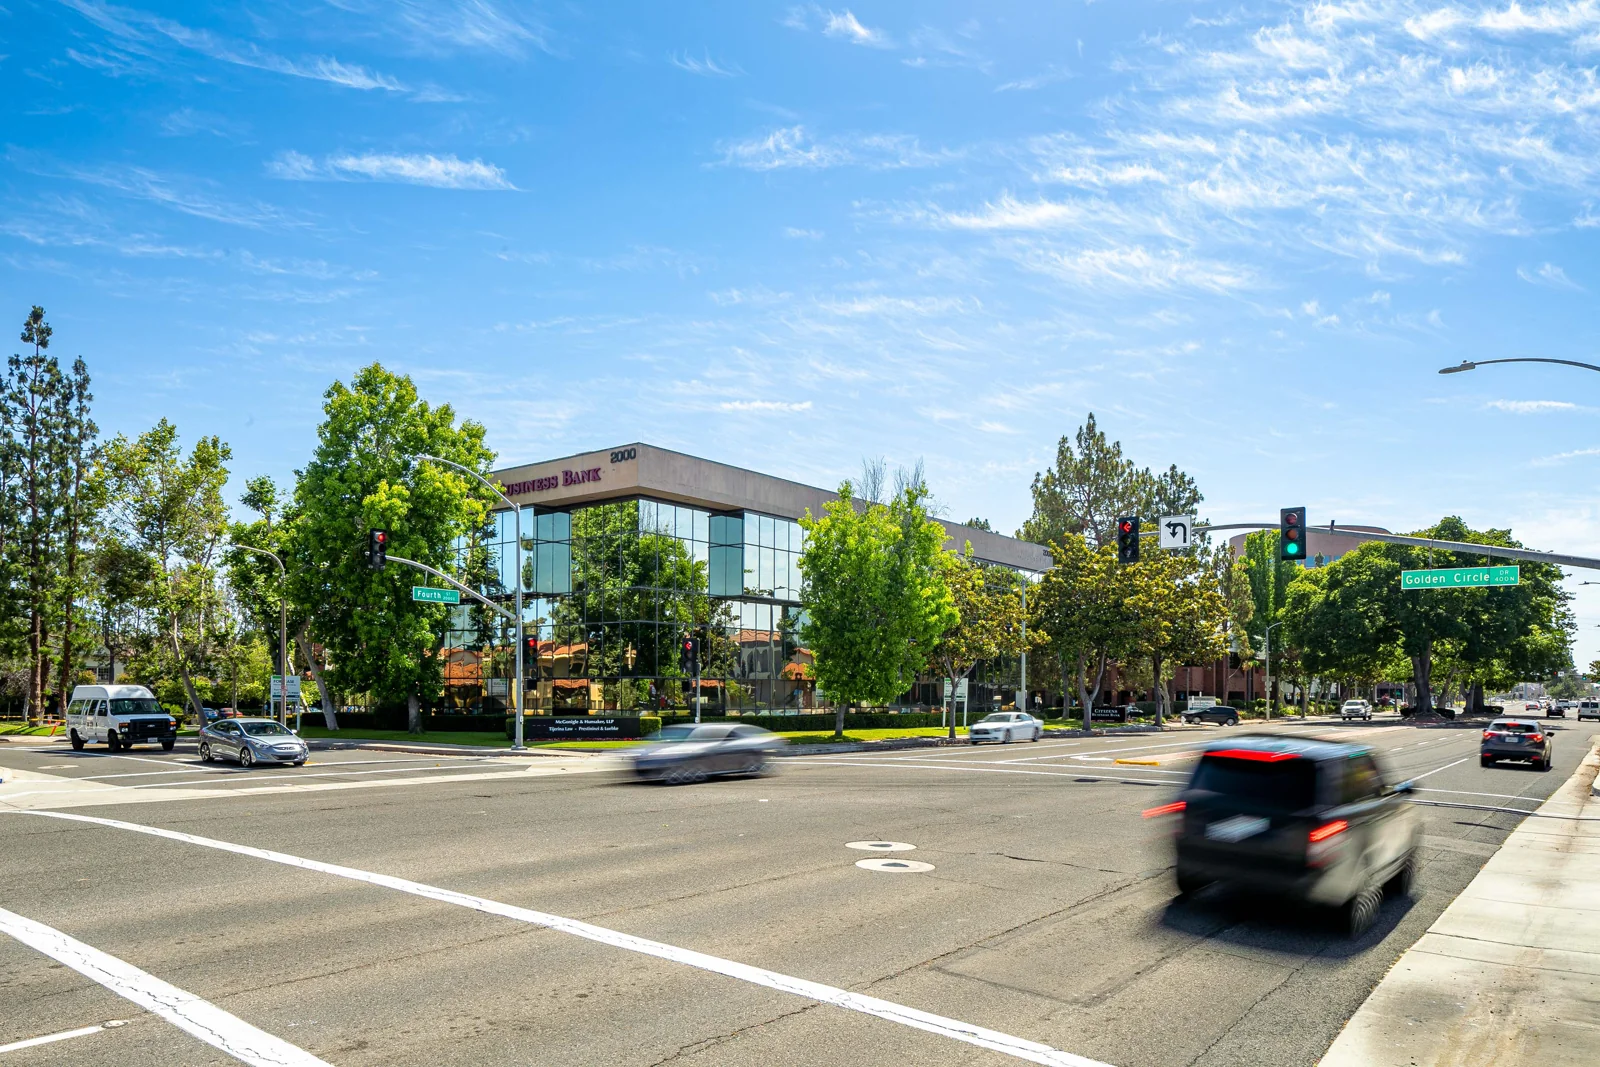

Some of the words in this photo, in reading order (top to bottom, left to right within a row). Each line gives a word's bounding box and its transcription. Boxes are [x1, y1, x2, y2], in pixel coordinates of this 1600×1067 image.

[610, 447, 637, 463] 2000
[562, 467, 601, 486] BANK
[1405, 575, 1446, 585] Golden
[1453, 572, 1490, 583] Circle
[417, 590, 442, 599] Fourth
